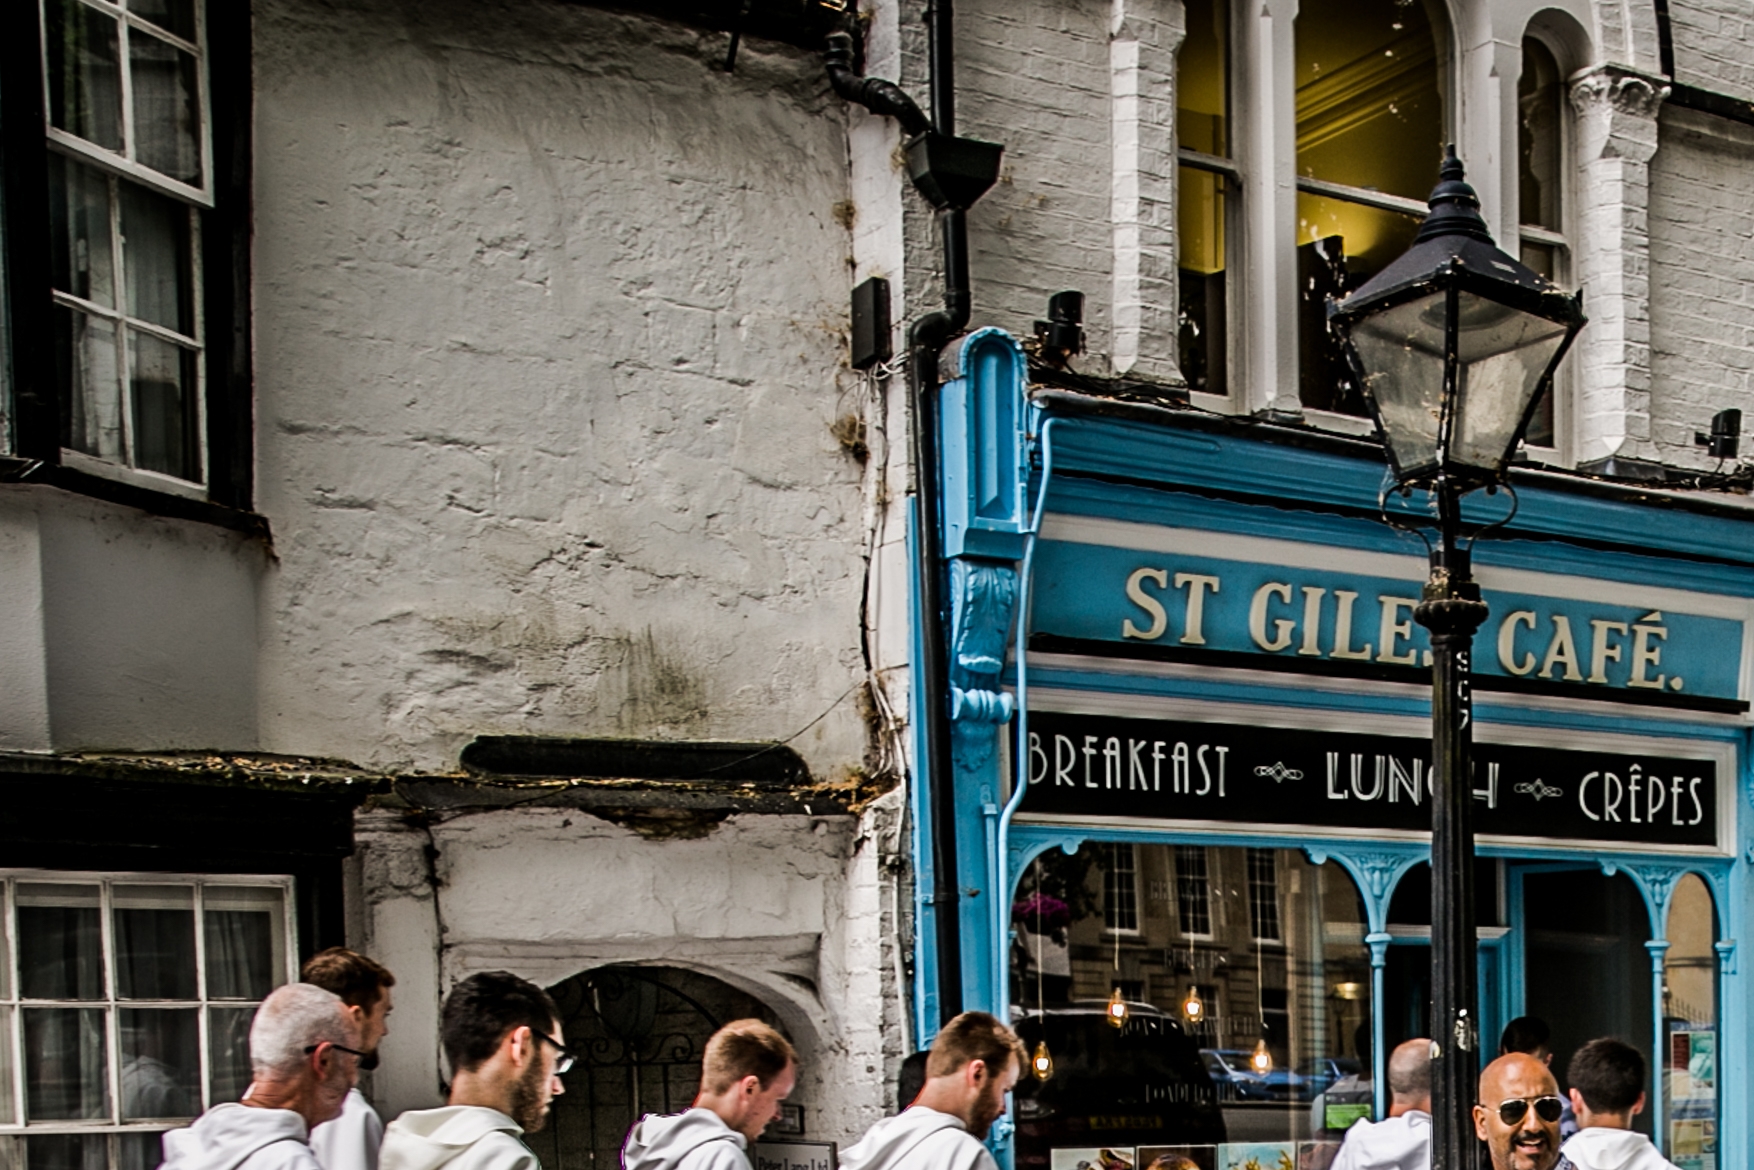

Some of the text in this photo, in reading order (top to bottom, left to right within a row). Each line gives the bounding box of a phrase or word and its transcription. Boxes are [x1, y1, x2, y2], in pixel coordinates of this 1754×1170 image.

[1122, 566, 1684, 691] ST GILE CAFÉ.
[1028, 731, 1703, 826] BREAKFAST LUNH CRÊPES
